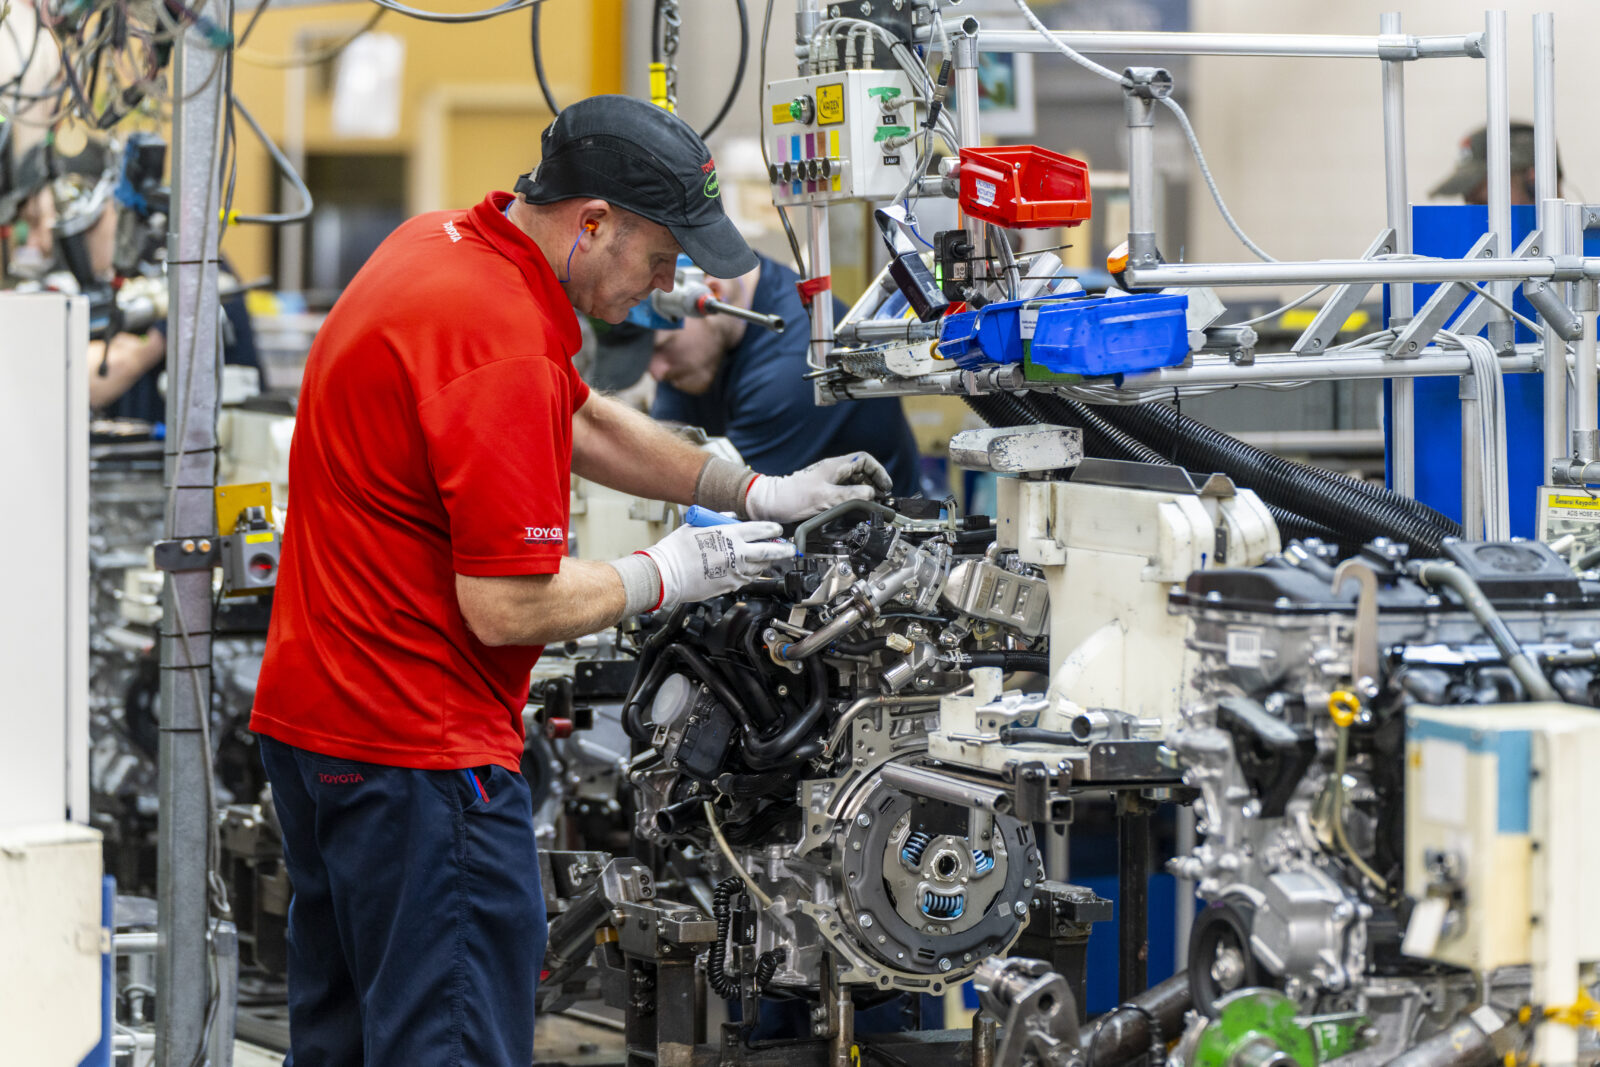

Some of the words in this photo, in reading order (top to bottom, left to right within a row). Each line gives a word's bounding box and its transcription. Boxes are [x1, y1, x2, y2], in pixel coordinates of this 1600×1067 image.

[442, 220, 463, 243] TOYOTA
[726, 537, 736, 569] arco
[318, 772, 365, 784] TOYOTA
